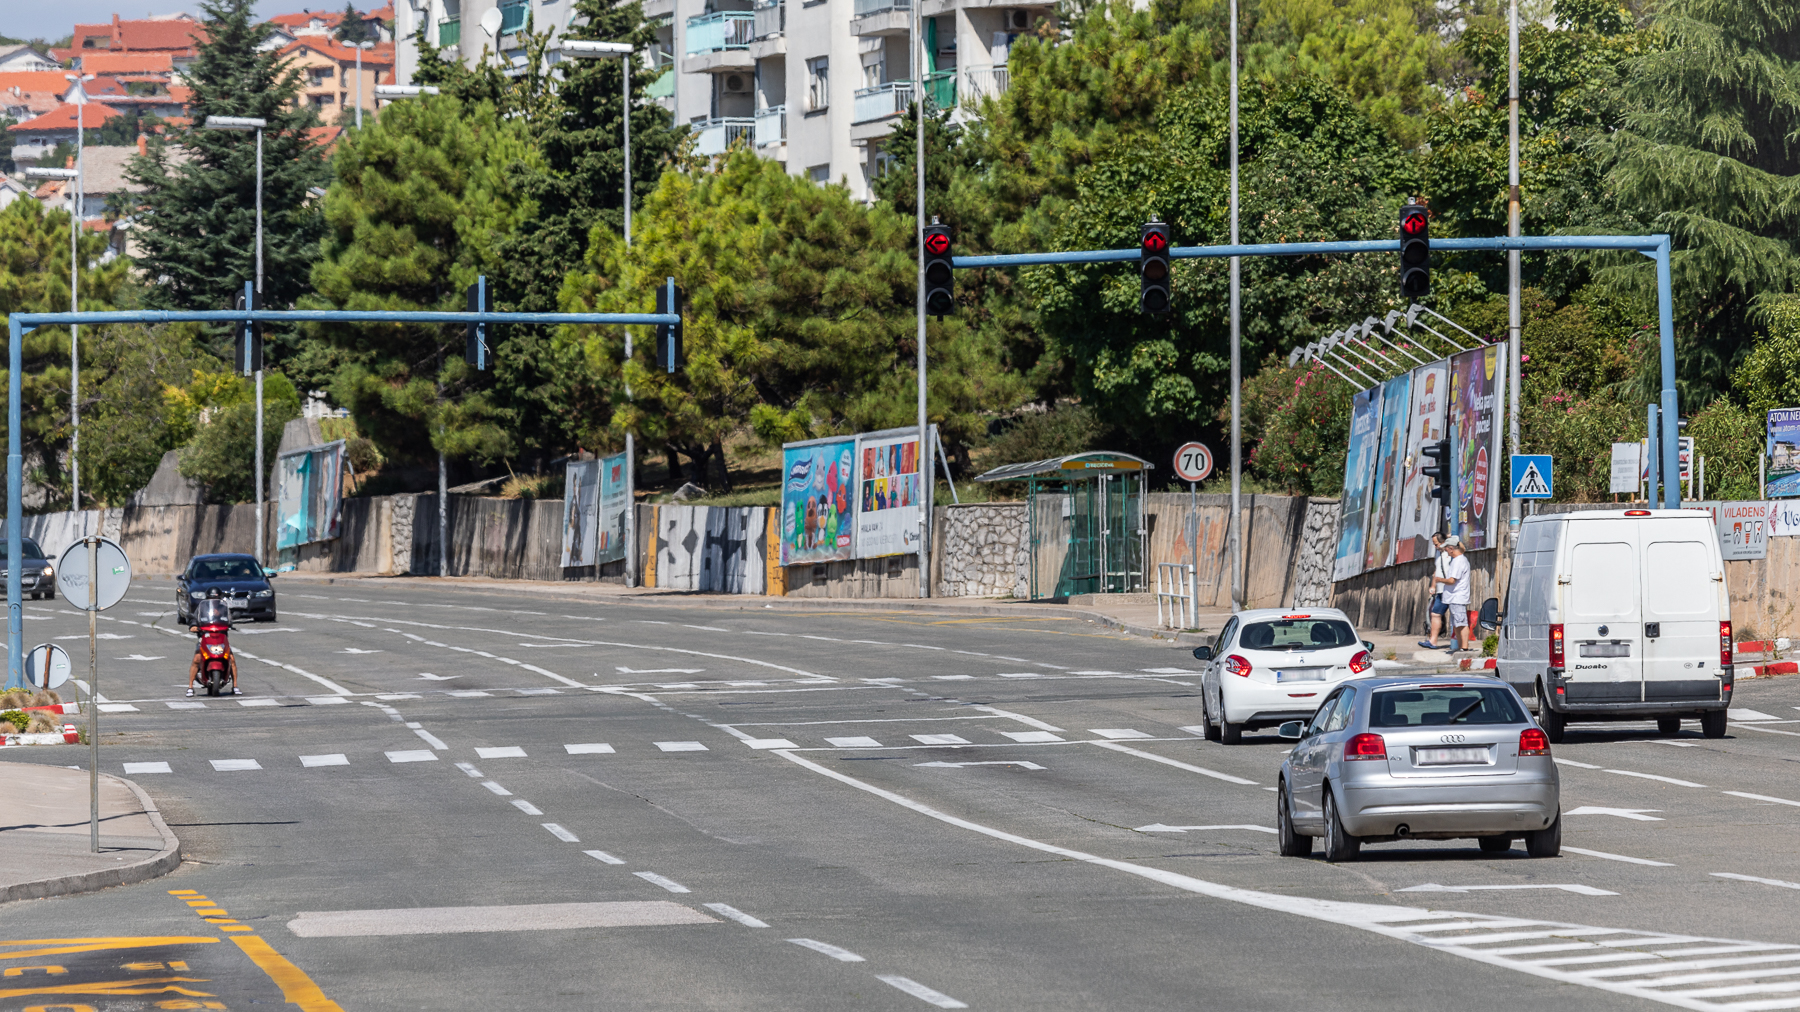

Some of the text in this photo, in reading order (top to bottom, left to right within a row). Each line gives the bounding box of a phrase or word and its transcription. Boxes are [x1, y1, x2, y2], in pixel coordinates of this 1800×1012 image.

[1769, 410, 1800, 423] ATOM NE
[1183, 453, 1205, 471] 70
[1724, 506, 1765, 518] VILADENS
